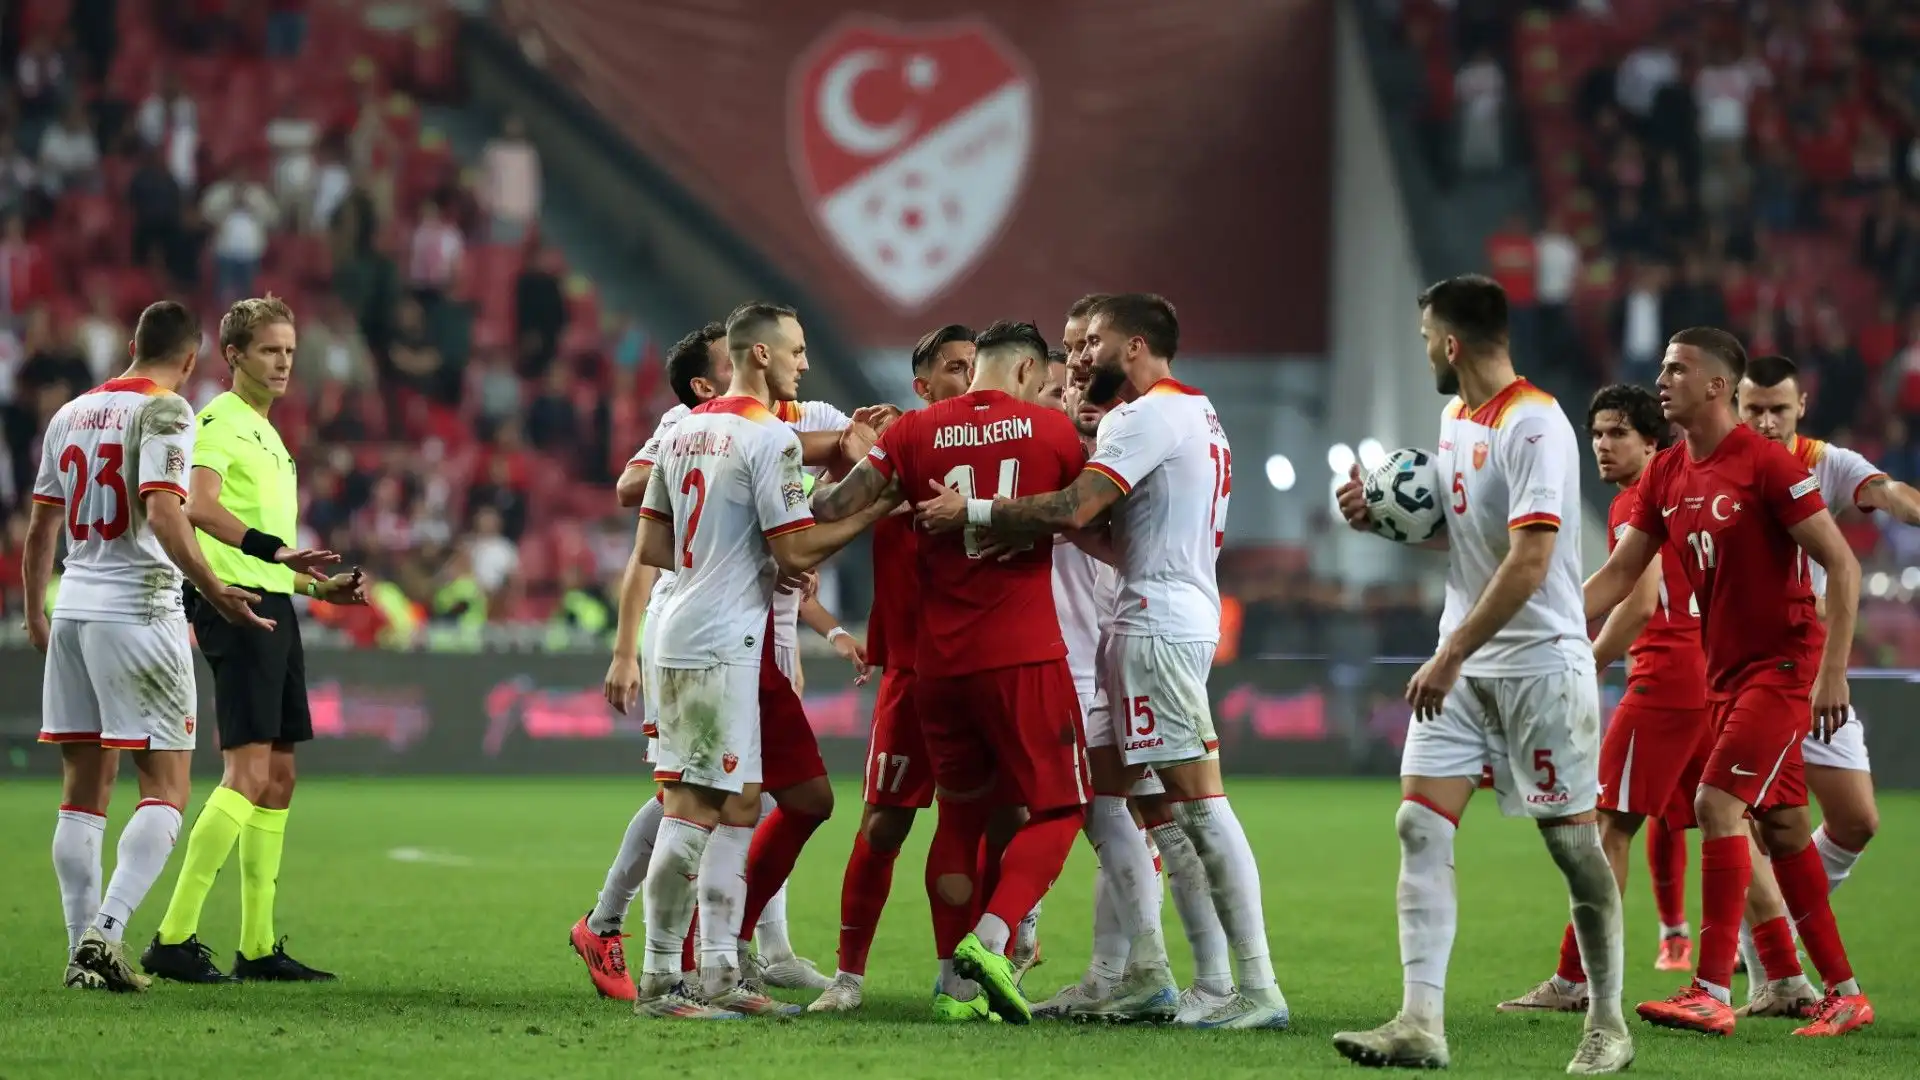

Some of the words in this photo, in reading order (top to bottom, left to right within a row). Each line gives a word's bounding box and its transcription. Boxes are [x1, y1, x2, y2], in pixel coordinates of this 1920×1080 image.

[934, 415, 1033, 449] ABDÜLKERİM
[60, 443, 130, 540] 23
[1453, 471, 1467, 515] 5
[681, 467, 706, 569] 2
[1687, 530, 1716, 570] 19
[1123, 695, 1155, 737] 15
[1124, 738, 1164, 751] LEGEA
[876, 752, 910, 793] 17
[1533, 748, 1556, 792] 5
[1527, 792, 1568, 803] LEGEA
